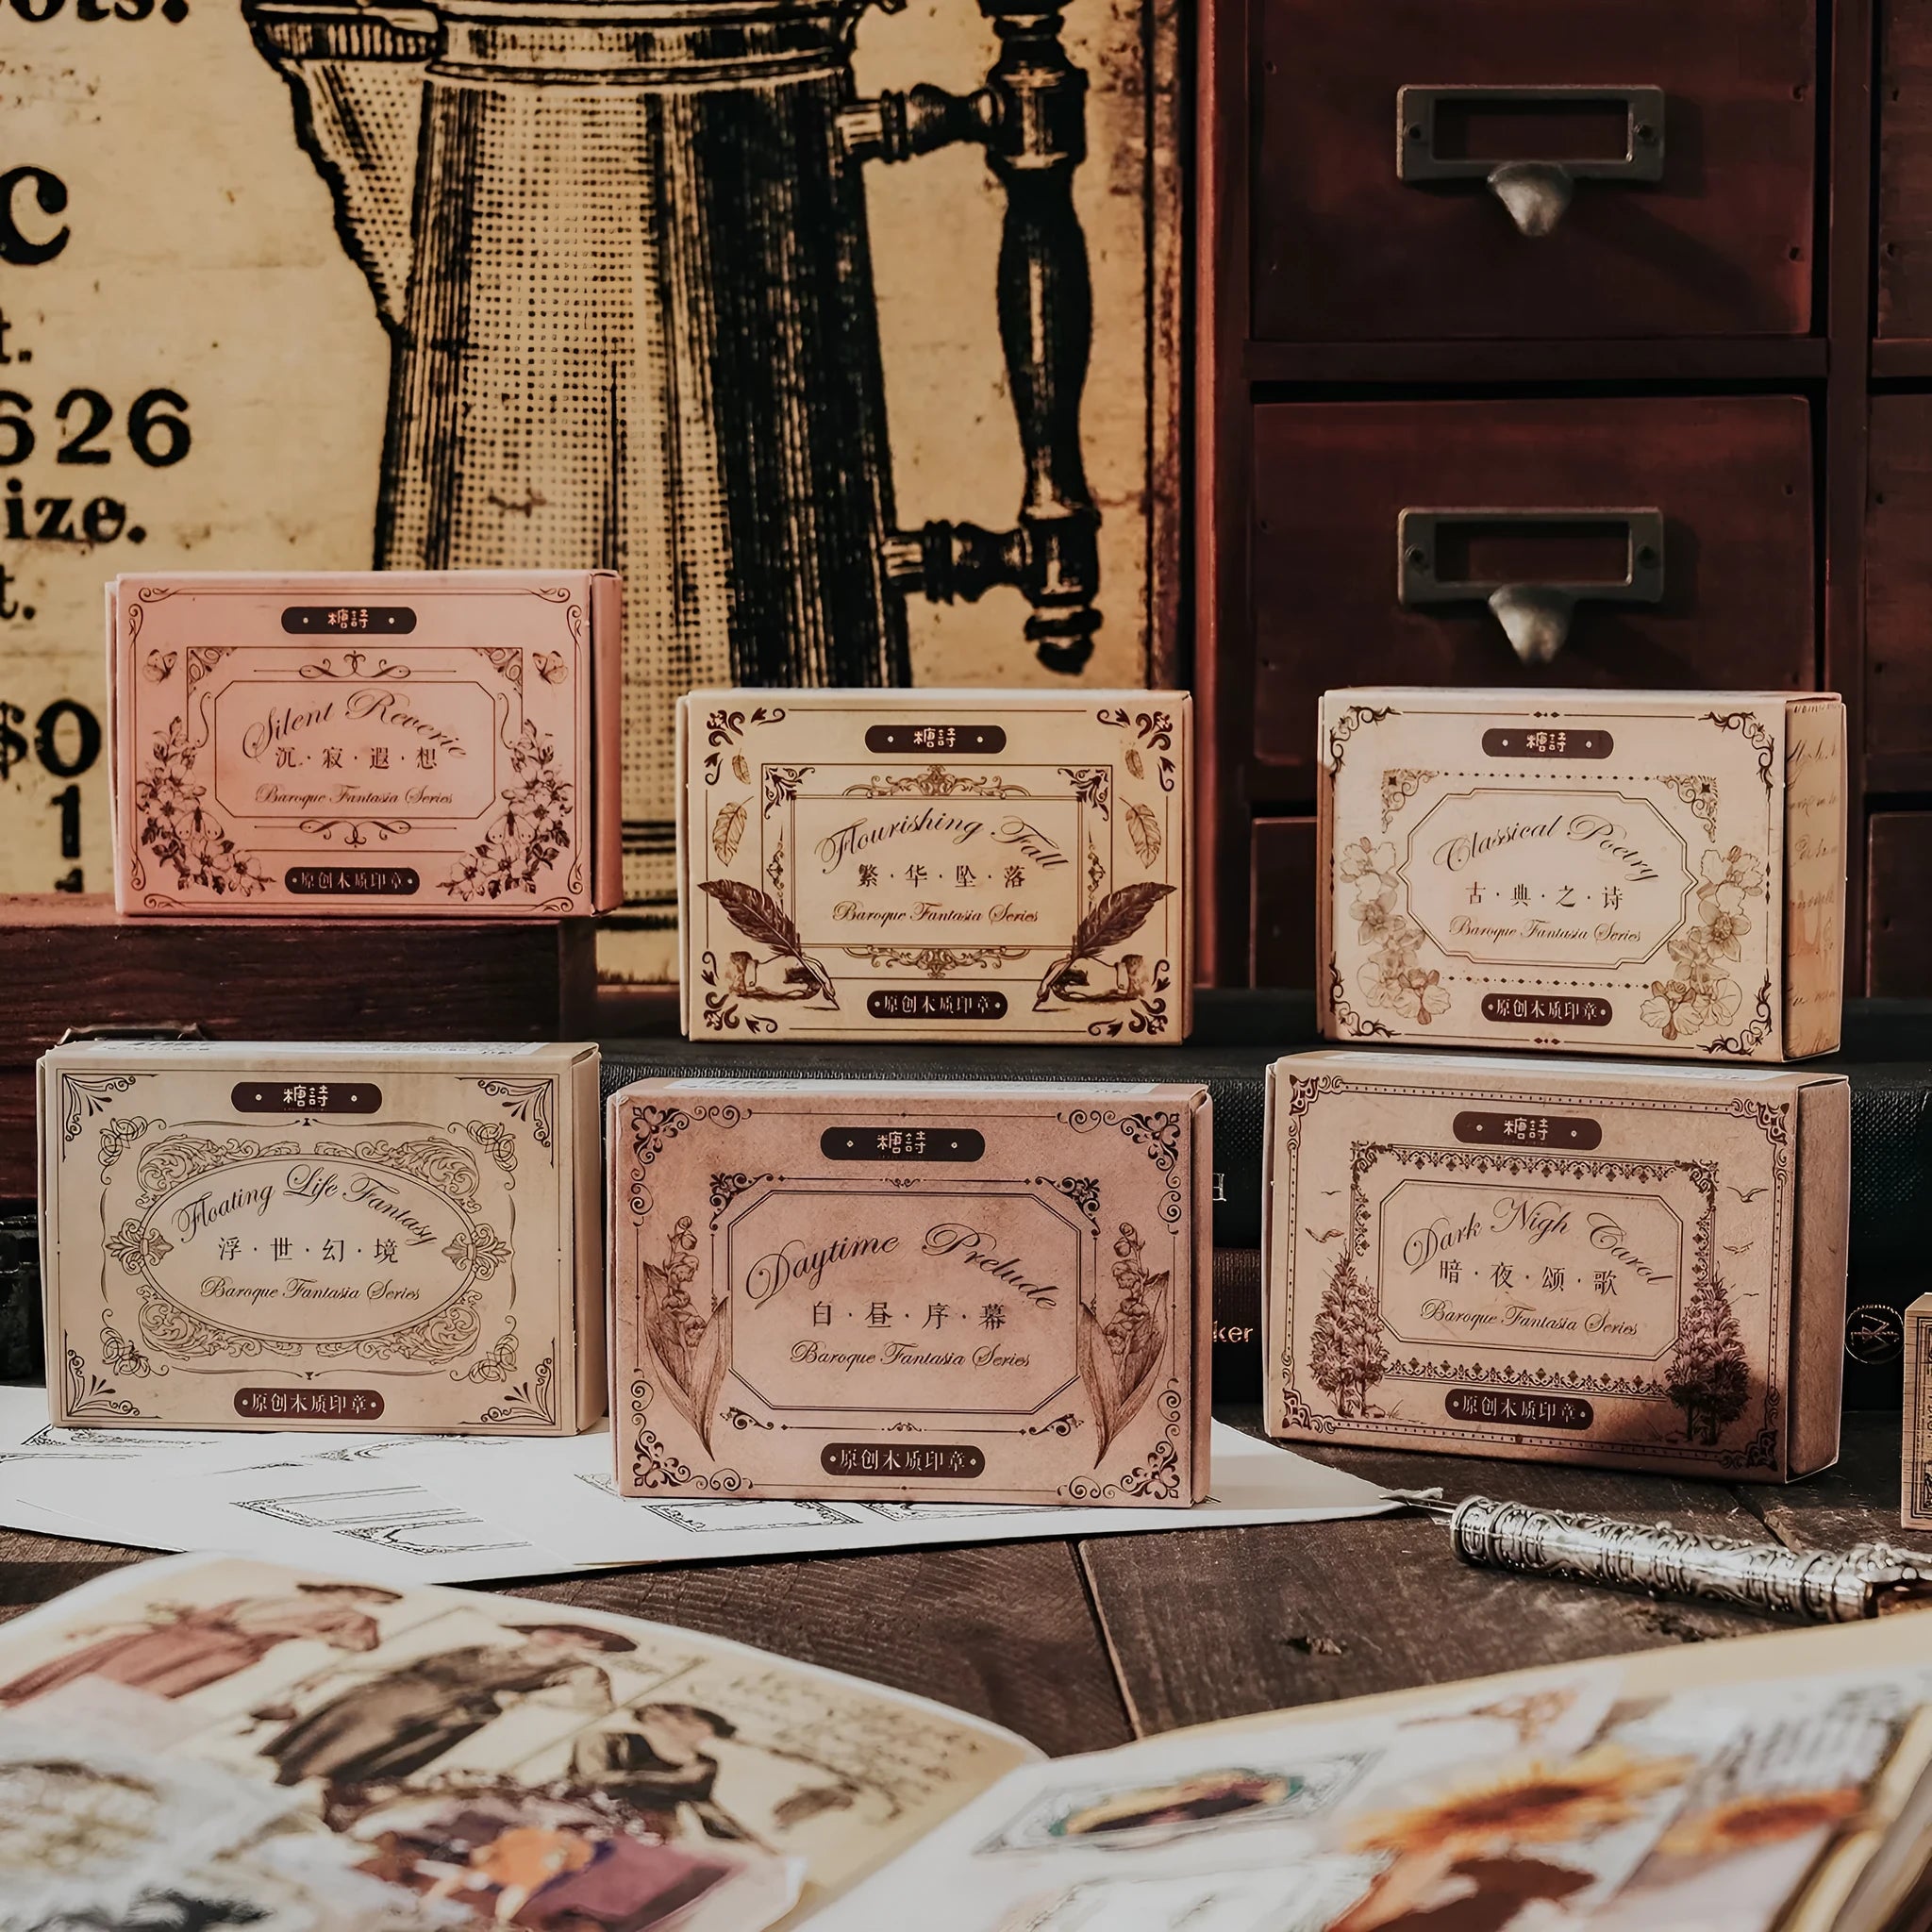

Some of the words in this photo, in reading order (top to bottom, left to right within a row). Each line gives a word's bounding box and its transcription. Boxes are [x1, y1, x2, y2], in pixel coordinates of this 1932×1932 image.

[242, 702, 333, 763] Silent
[344, 688, 467, 759] Reverie
[50, 785, 81, 858] 1
[255, 783, 326, 809] Baroque
[329, 784, 399, 804] Fantasia
[405, 784, 453, 805] Series
[814, 807, 984, 874] Flourishing
[991, 815, 1069, 871] Fall
[1433, 815, 1562, 872] Classical
[1567, 814, 1658, 882] Poetry
[832, 900, 906, 927] Baroque
[909, 901, 982, 922] Fantasia
[988, 901, 1039, 925] Series
[1449, 915, 1517, 943] Baroque
[1520, 919, 1589, 941] Fantasia
[1592, 921, 1641, 943] Series
[171, 1183, 275, 1243] Floating
[283, 1163, 339, 1207] Life
[342, 1173, 438, 1246] Fantasy
[1403, 1211, 1483, 1275] Dark
[1491, 1196, 1573, 1245] Nigh
[199, 1275, 278, 1306] Baroque
[282, 1276, 360, 1300] Fantasia
[366, 1279, 422, 1305] Series
[745, 1238, 900, 1310] Daytime
[921, 1223, 1059, 1311] Prelude
[1420, 1298, 1499, 1331] Baroque
[1501, 1304, 1578, 1332] Fantasia
[1584, 1308, 1639, 1337] Series
[790, 1339, 876, 1372] Baroque
[880, 1340, 966, 1366] Fantasia
[972, 1342, 1032, 1369] Series
[251, 1392, 367, 1414] 原创木质印章
